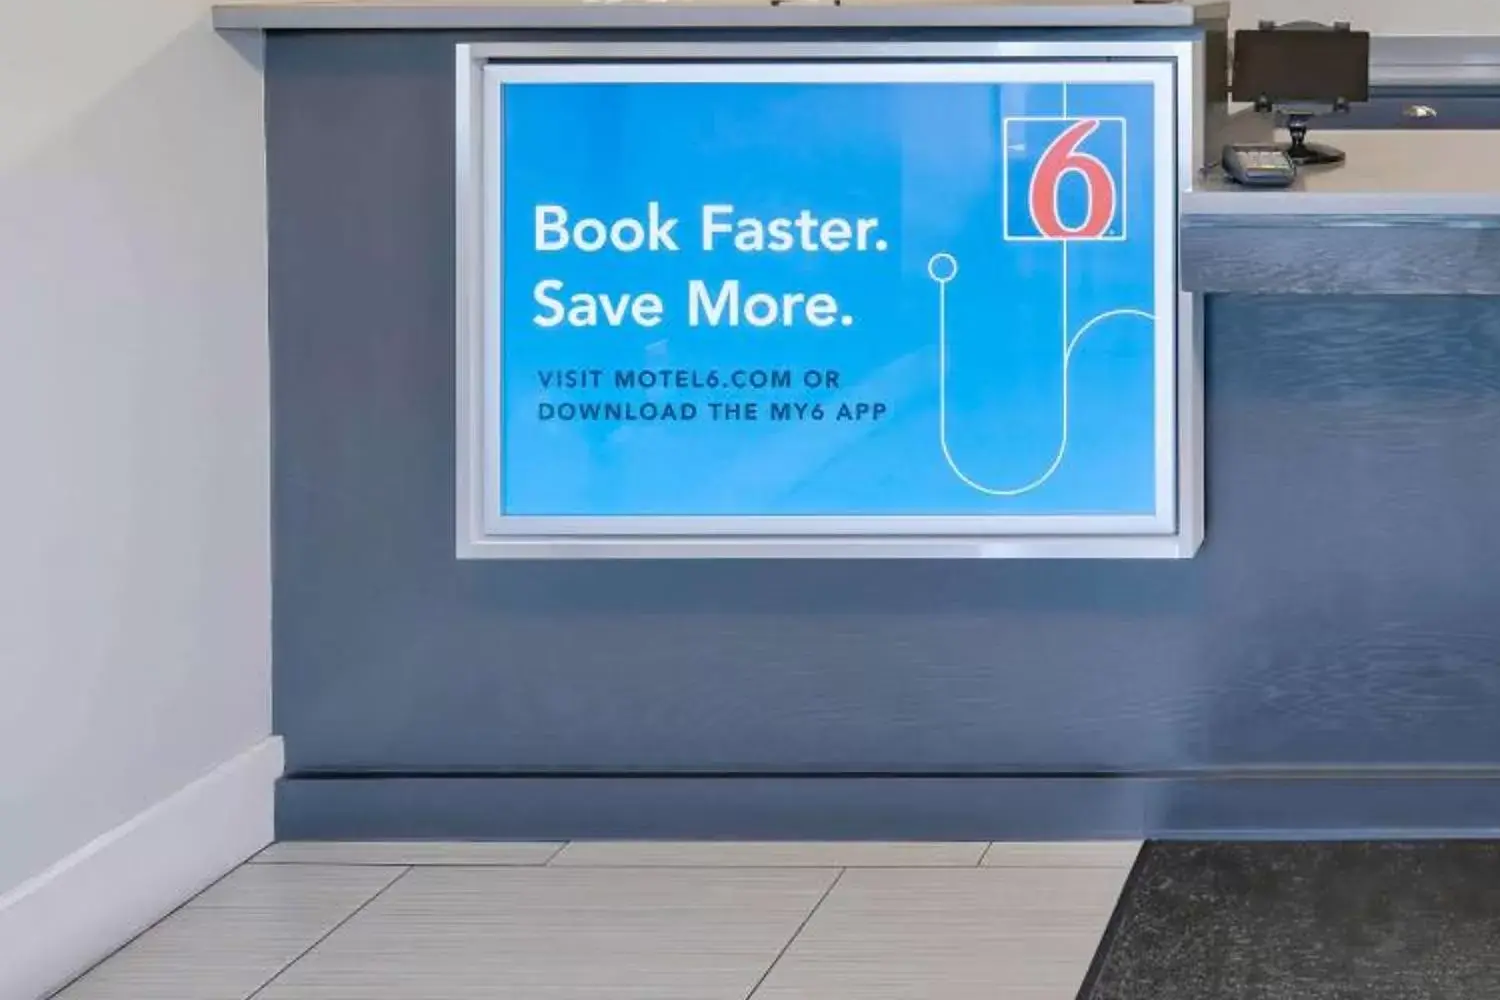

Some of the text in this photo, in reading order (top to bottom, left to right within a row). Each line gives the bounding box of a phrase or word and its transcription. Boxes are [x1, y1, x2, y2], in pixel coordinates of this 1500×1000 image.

[1028, 119, 1116, 240] 6
[534, 201, 888, 252] Book Faster.
[532, 279, 854, 328] Save More.
[538, 369, 841, 390] VISIT MOTEL6.COM OR
[538, 402, 888, 422] DOWNLOAD THE MY6 APP
